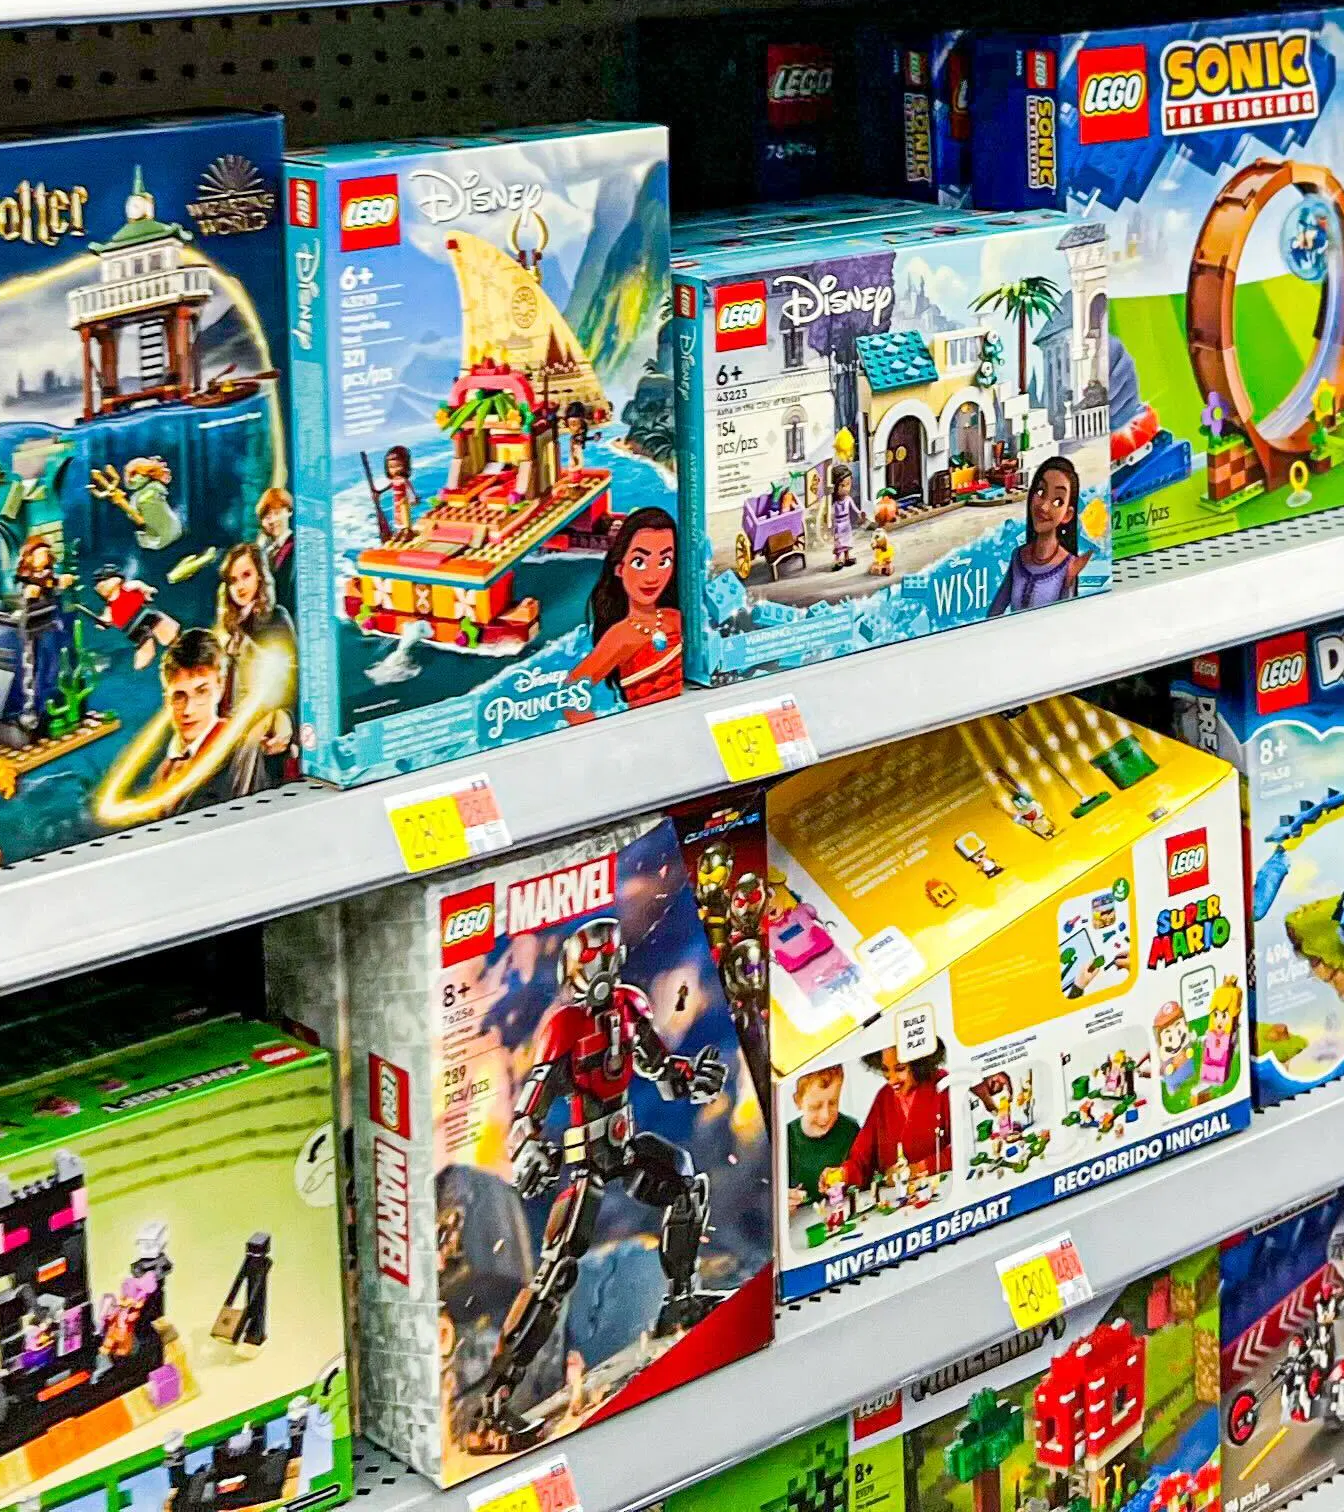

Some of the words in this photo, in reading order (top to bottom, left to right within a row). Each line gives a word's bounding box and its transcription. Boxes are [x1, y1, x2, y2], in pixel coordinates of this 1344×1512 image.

[772, 66, 832, 96] LEGO
[1084, 74, 1141, 113] LEGO
[1167, 37, 1311, 98] SONIC
[1167, 106, 1204, 127] THE
[1213, 94, 1313, 121] HEDGEHOG
[1037, 98, 1055, 186] SONIC
[344, 198, 396, 228] LEGO
[409, 170, 542, 225] Disney
[340, 266, 373, 290] 6+
[719, 303, 763, 330] LEGO
[773, 275, 892, 326] Disney
[716, 365, 742, 385] 6+
[716, 389, 748, 402] 43223
[717, 421, 736, 437] 154
[716, 433, 759, 457] pcs/pzs
[1127, 503, 1169, 531] pcs/pzs
[934, 567, 988, 617] WISH
[1194, 662, 1218, 678] LEGO
[1262, 655, 1304, 690] LEGO
[485, 680, 592, 738] PRINCESS
[1259, 739, 1288, 765] 8+
[1171, 847, 1205, 876] LEGO
[445, 906, 491, 943] LEGO
[509, 859, 614, 934] MARVEL
[1157, 894, 1220, 935] SUPER
[1147, 916, 1230, 970] MARIO
[443, 982, 470, 1007] 8+
[903, 1014, 926, 1029] BUILD
[907, 1026, 925, 1039] AND
[907, 1037, 926, 1049] PLAY
[443, 1065, 467, 1087] 289
[381, 1065, 399, 1128] LEGO
[444, 1078, 490, 1106] pcs/pzs
[377, 1139, 408, 1278] MARVEL
[824, 1243, 900, 1284] NIVEAU
[904, 1226, 931, 1259] DE
[935, 1192, 1012, 1240] DÉPART
[1054, 1139, 1163, 1196] RECORRIDO
[1165, 1117, 1232, 1152] INICIAL
[855, 1463, 874, 1483] 8+
